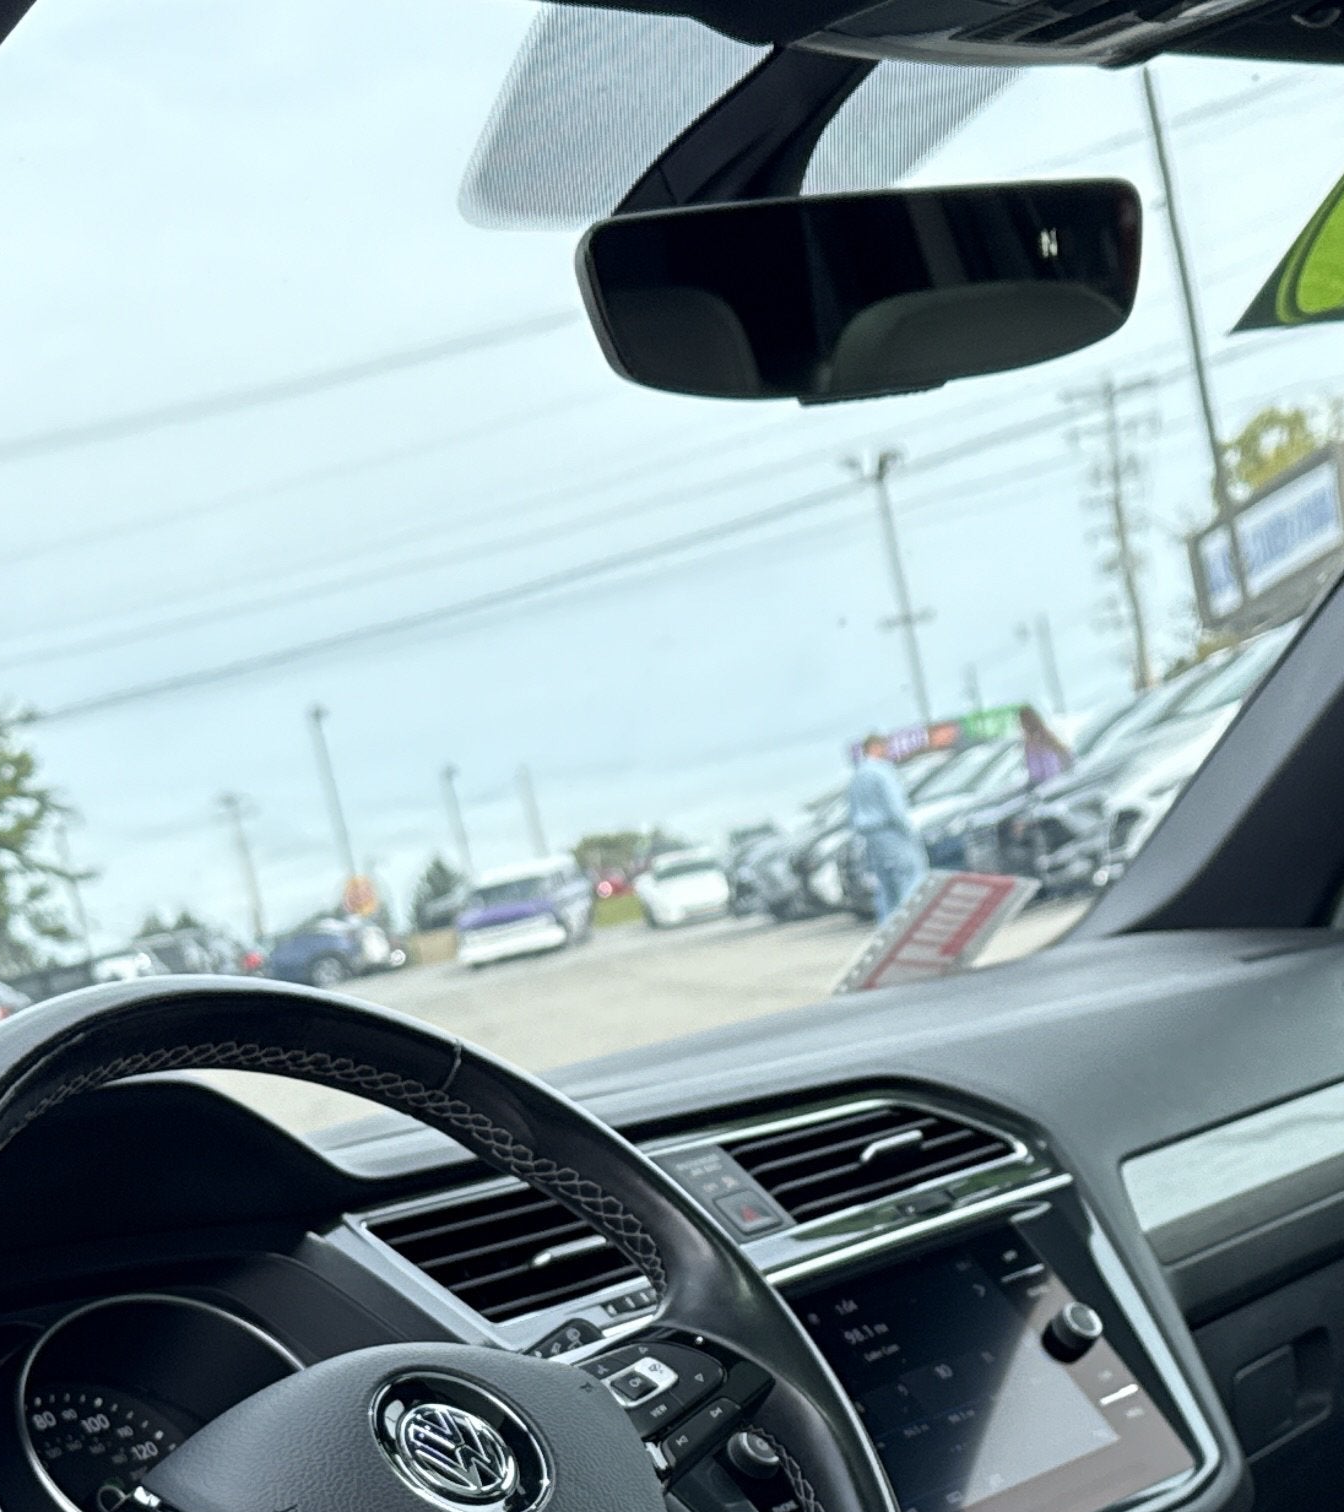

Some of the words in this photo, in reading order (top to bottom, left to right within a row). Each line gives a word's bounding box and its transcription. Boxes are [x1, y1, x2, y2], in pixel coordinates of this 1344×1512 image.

[32, 1410, 57, 1431] 80
[80, 1412, 111, 1434] 100
[130, 1440, 159, 1461] 120
